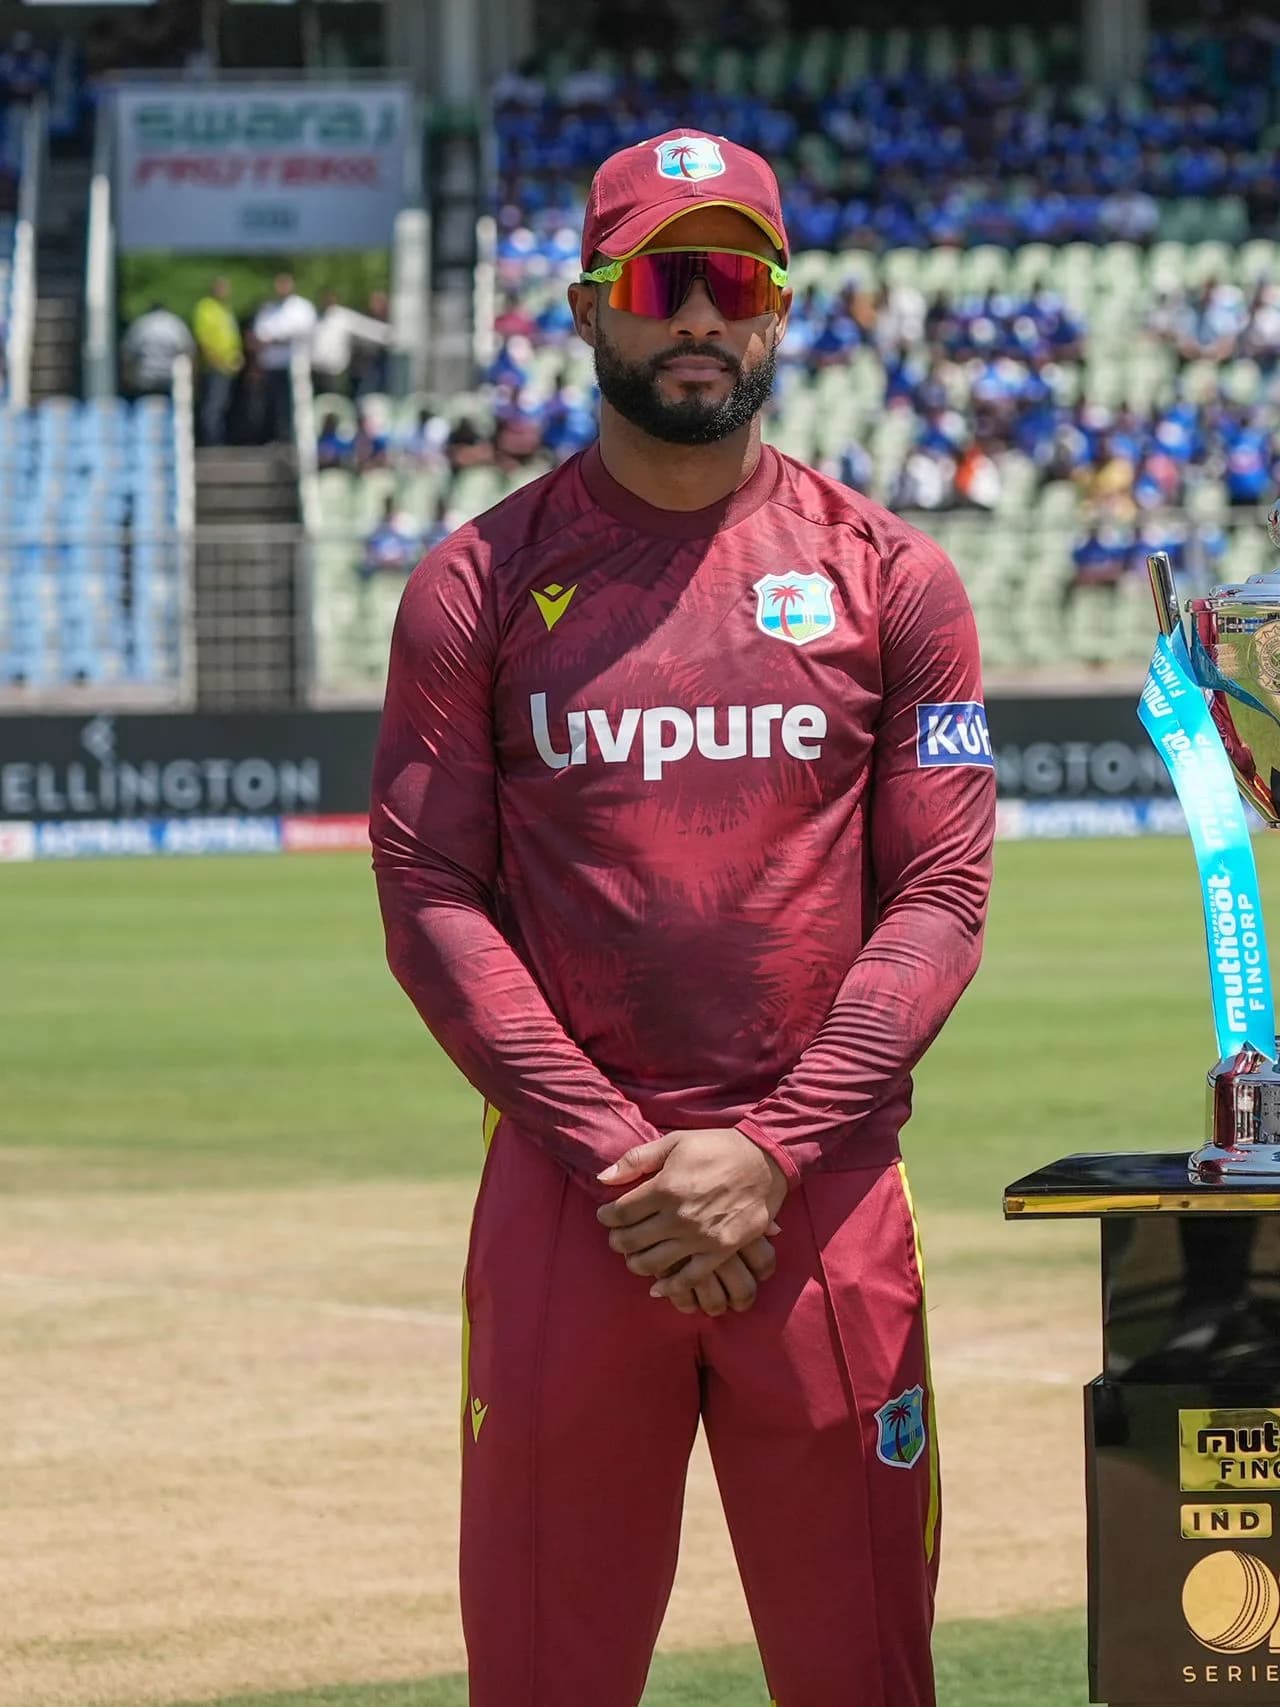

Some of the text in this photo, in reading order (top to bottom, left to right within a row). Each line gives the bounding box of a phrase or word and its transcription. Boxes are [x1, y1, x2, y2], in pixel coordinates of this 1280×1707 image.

[530, 692, 827, 781] Livpure
[1208, 873, 1248, 1032] muthoot
[1238, 893, 1265, 1011] FINCORP
[1193, 1511, 1260, 1531] IND
